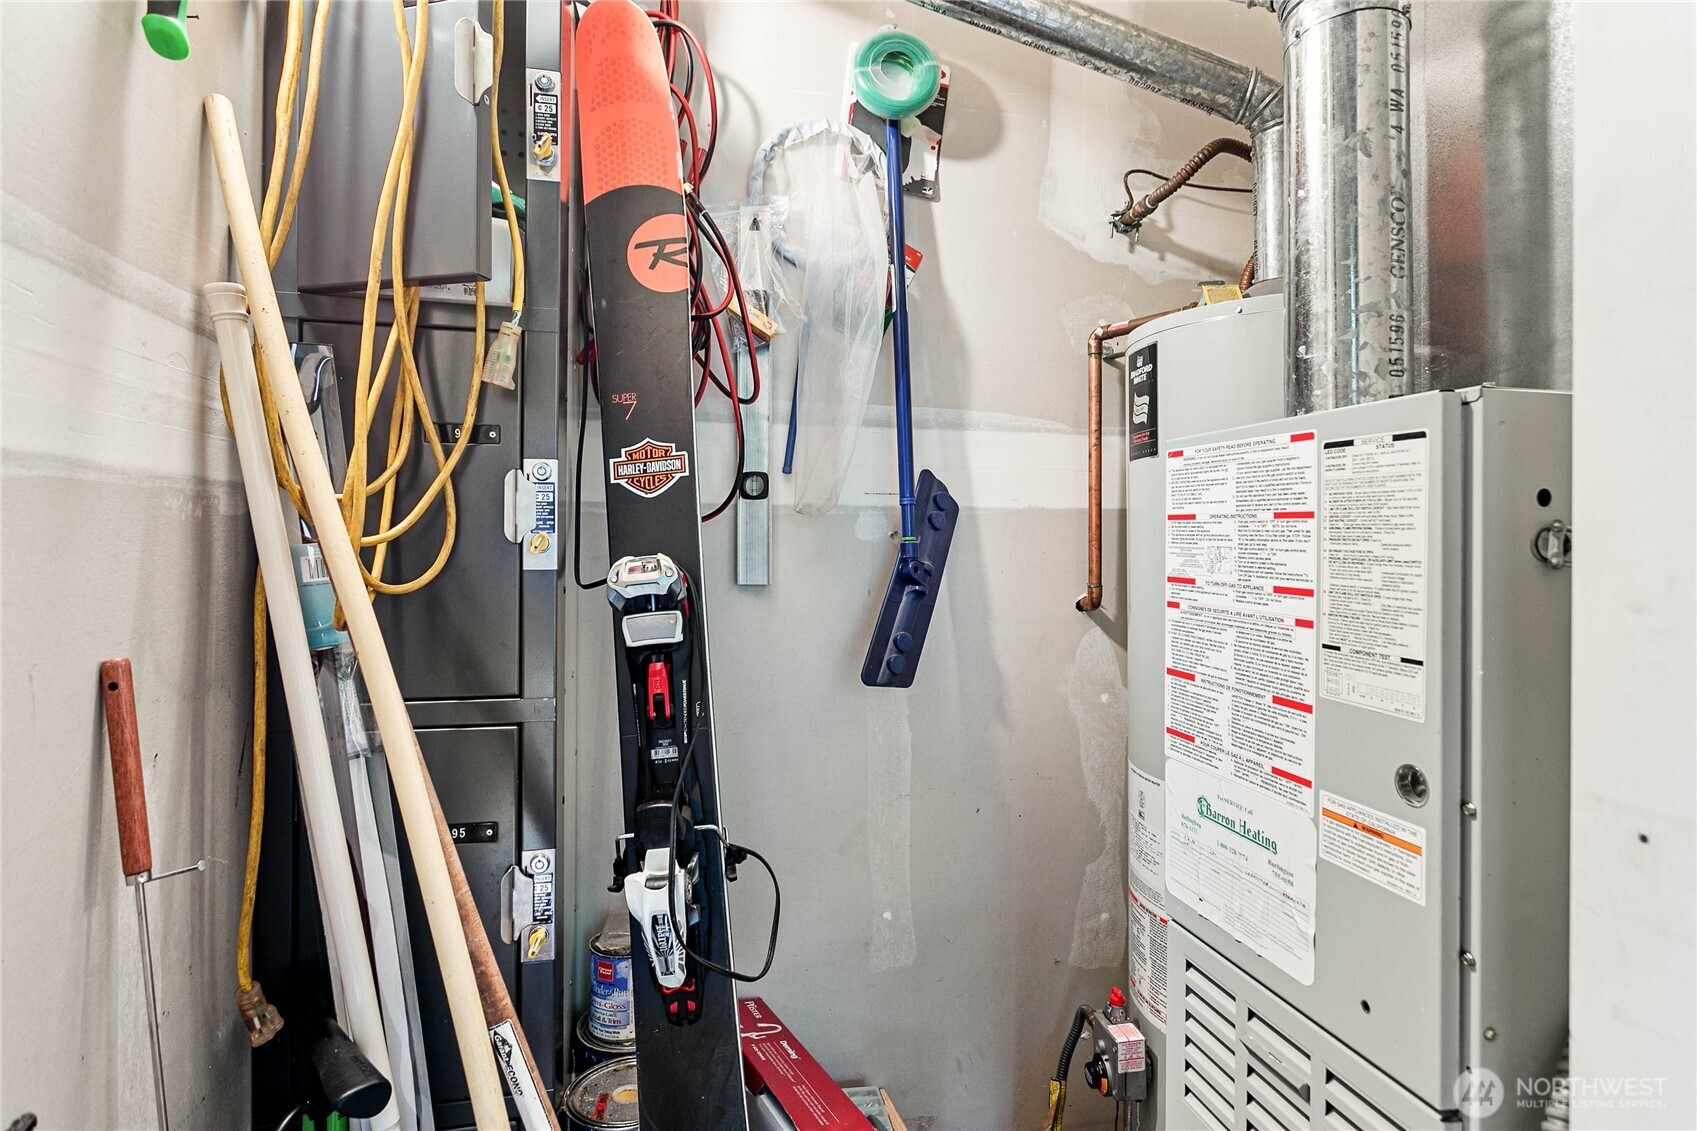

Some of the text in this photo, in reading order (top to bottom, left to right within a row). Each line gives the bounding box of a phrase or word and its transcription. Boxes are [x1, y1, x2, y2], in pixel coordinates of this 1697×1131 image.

[1390, 88, 1404, 112] WA
[1390, 196, 1405, 280] GENSCO
[1389, 314, 1404, 378] 051596
[612, 393, 637, 403] SUPER
[622, 401, 637, 420] 7
[632, 446, 665, 460] MOTOR
[618, 459, 681, 476] HARLEY-DAVIDSON
[634, 474, 667, 490] CYCLES
[1349, 648, 1377, 658] COMPONENT
[1200, 678, 1225, 689] INSTRUCTIONS
[1210, 744, 1224, 753] COUPER
[1346, 805, 1373, 820] APPLIANCES
[452, 828, 466, 838] 95
[1206, 802, 1278, 855] Barron Heating
[1361, 825, 1384, 838] WARNING
[1368, 820, 1395, 834] CALIFORNIA
[495, 1035, 523, 1096] Garant ECONO
